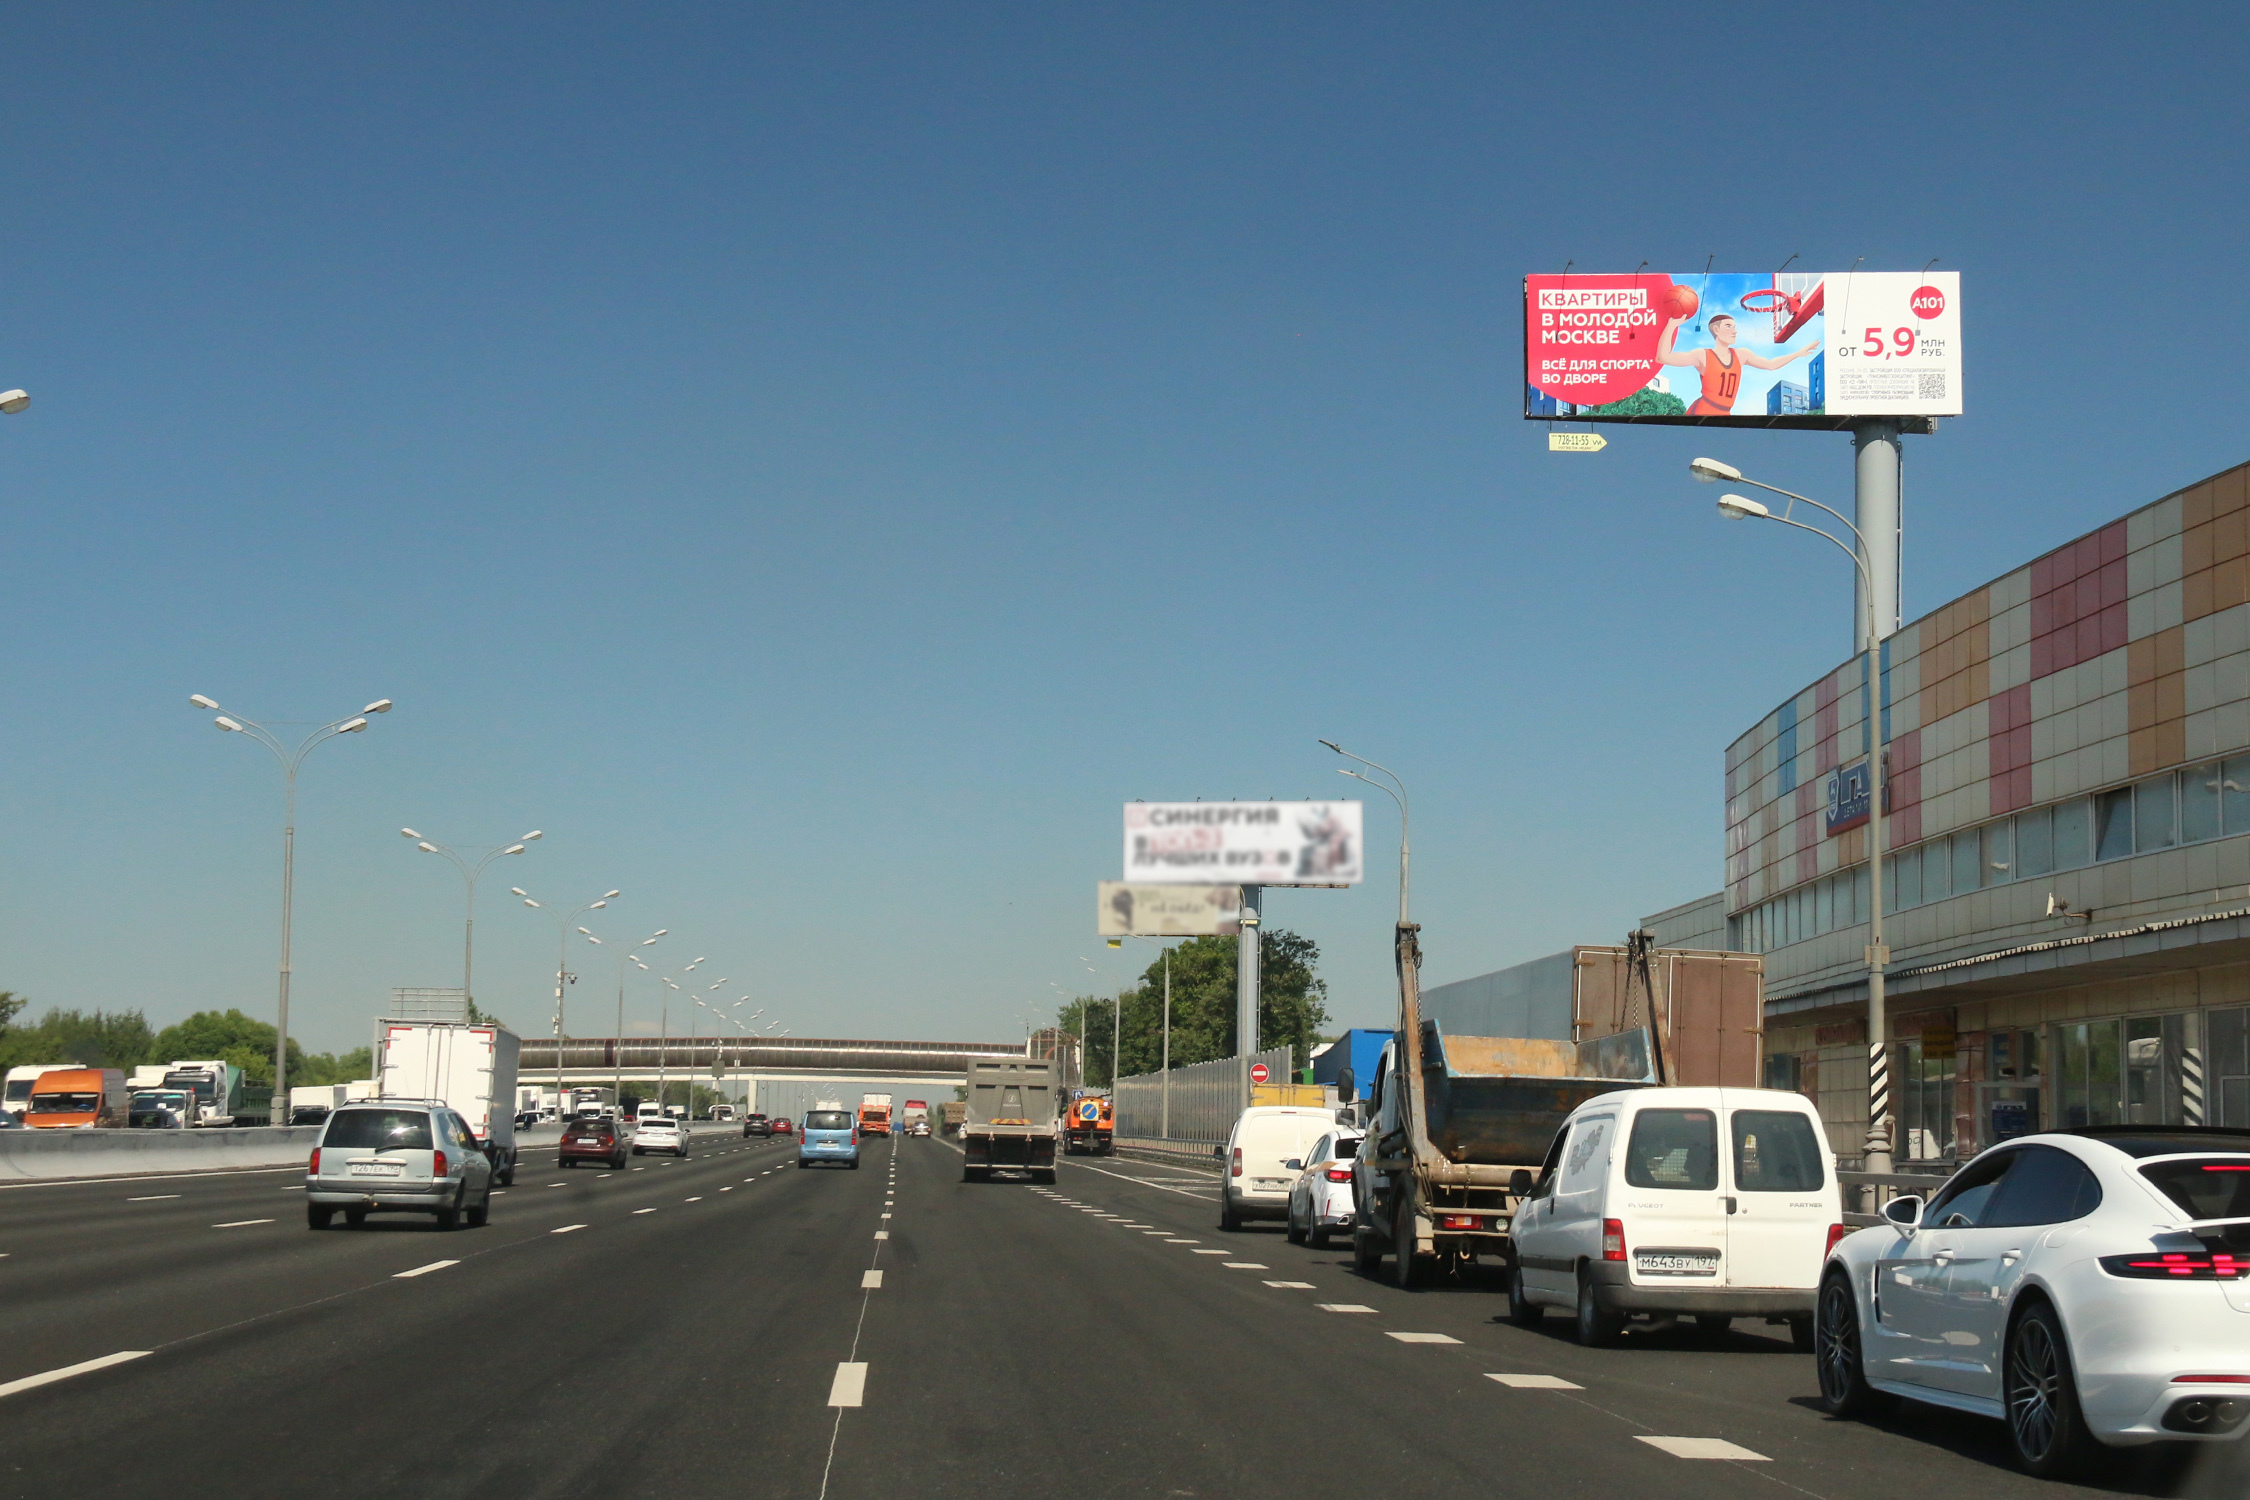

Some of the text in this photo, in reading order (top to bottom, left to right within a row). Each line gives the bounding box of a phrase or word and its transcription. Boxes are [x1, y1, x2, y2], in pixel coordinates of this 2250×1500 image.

[1541, 292, 1644, 306] КВАРТИРЫ
[1911, 296, 1944, 309] А101
[1541, 309, 1657, 328] В МОЛОДОЙ
[1541, 330, 1620, 344] МОСКВЕ
[1838, 326, 1915, 361] ОТ 5,9
[1920, 339, 1946, 347] МЛН
[1920, 348, 1946, 357] РУБ.
[1541, 357, 1567, 370] ВСЁ
[1569, 360, 1597, 371] ДЛЯ
[1541, 373, 1608, 385] ВО ДВОРЕ
[1718, 371, 1737, 398] 10
[1558, 434, 1589, 446] 728-11-55
[1150, 807, 1280, 826] СИНЕРГИЯ
[1641, 1255, 1713, 1269] М643ВУ 197
